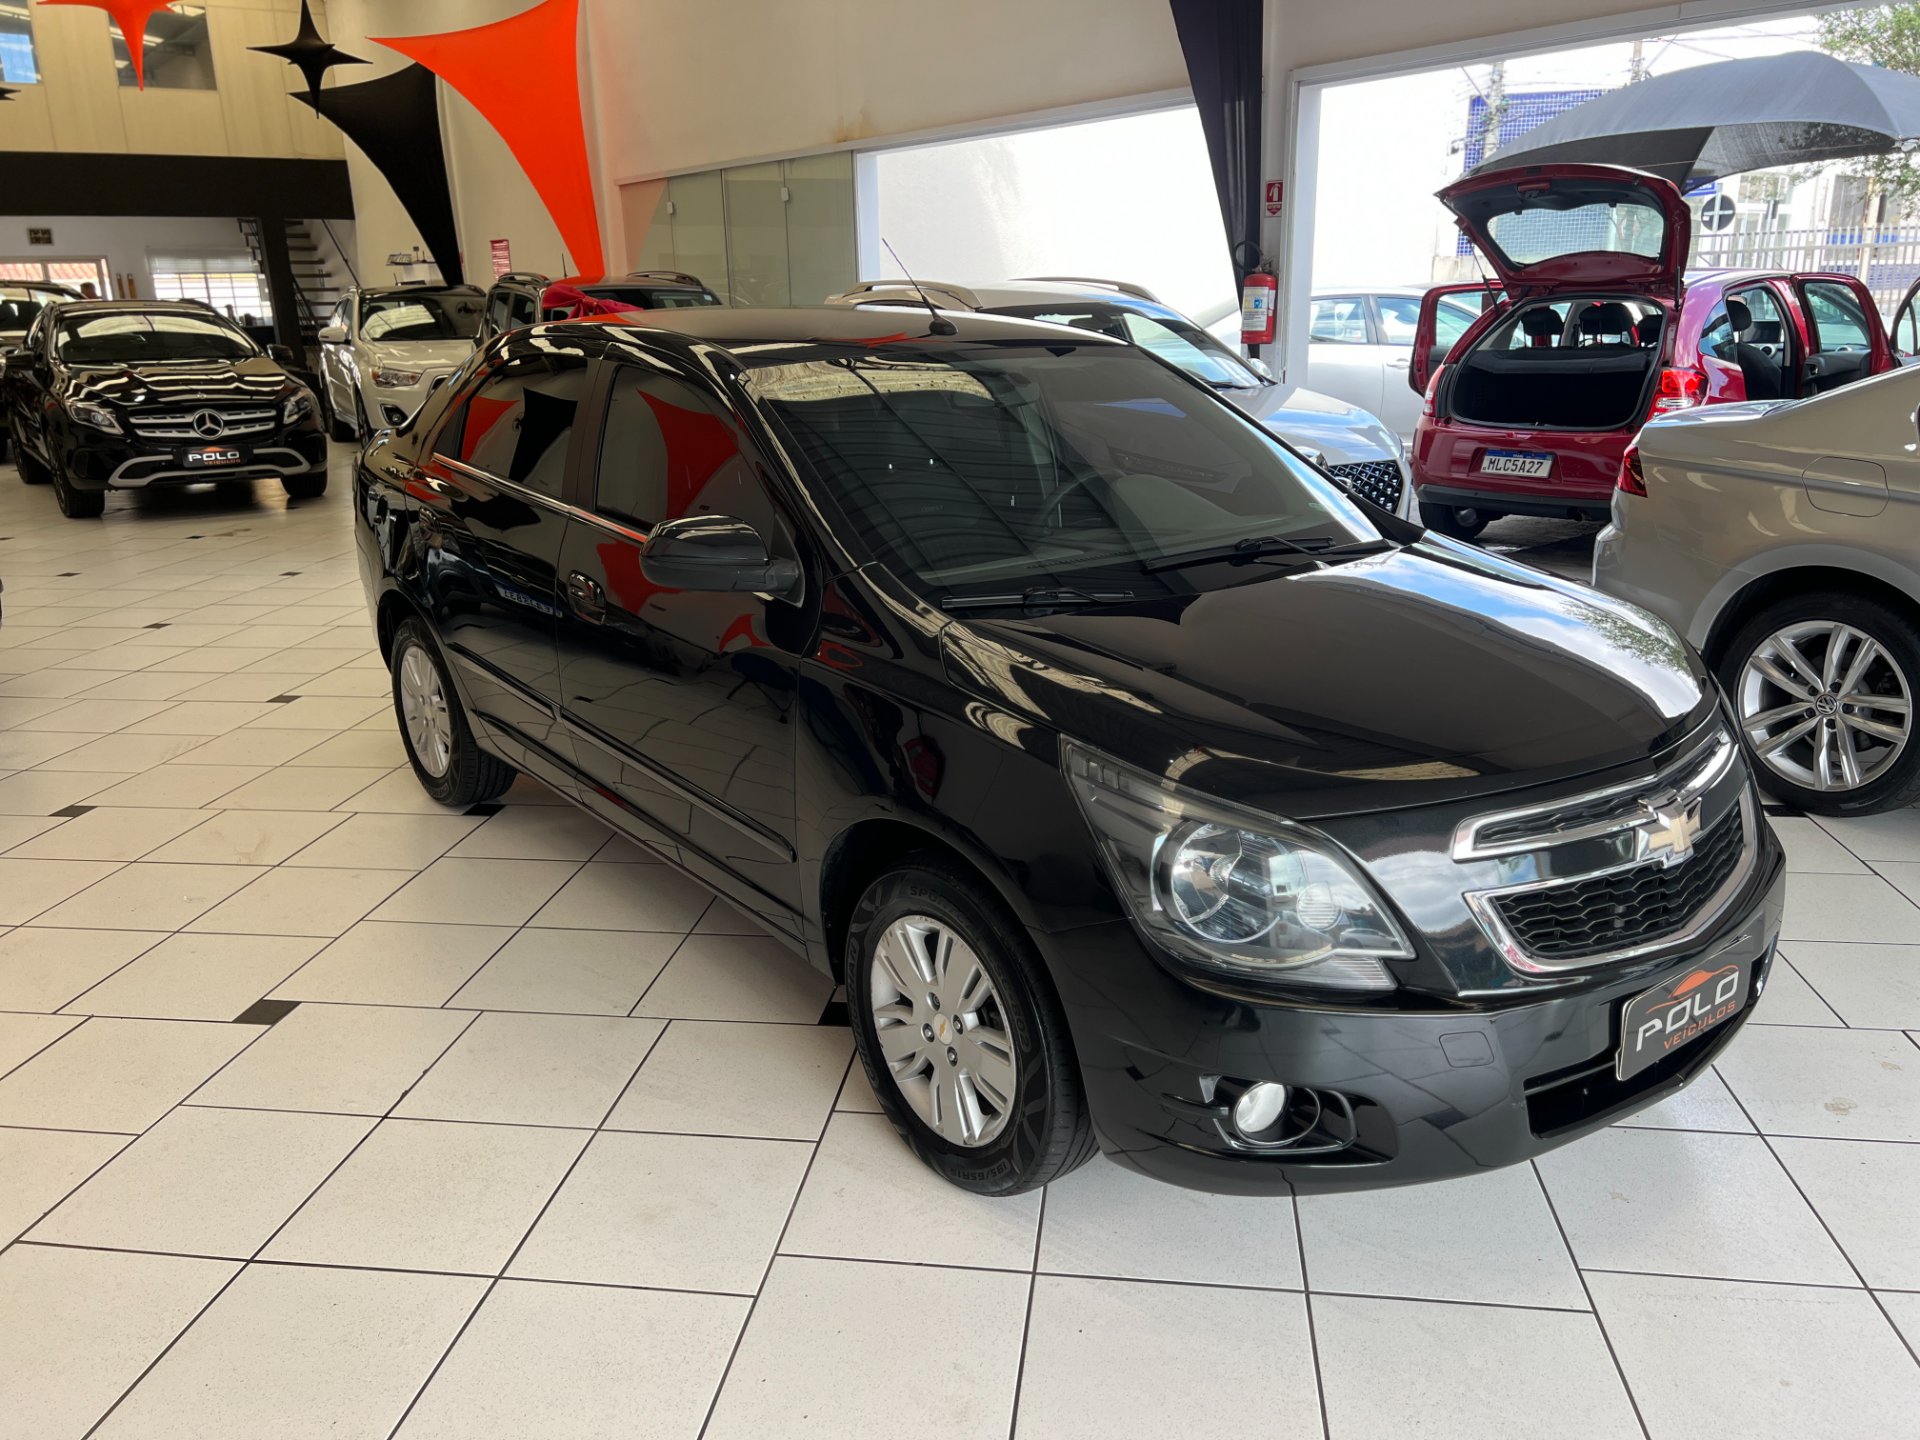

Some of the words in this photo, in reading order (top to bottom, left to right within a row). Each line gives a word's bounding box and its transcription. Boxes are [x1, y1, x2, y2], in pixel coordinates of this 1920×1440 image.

[188, 452, 240, 461] POLO
[1487, 458, 1543, 473] MLC5A27
[1636, 971, 1739, 1052] POLO
[1664, 1001, 1736, 1048] VEICULOS
